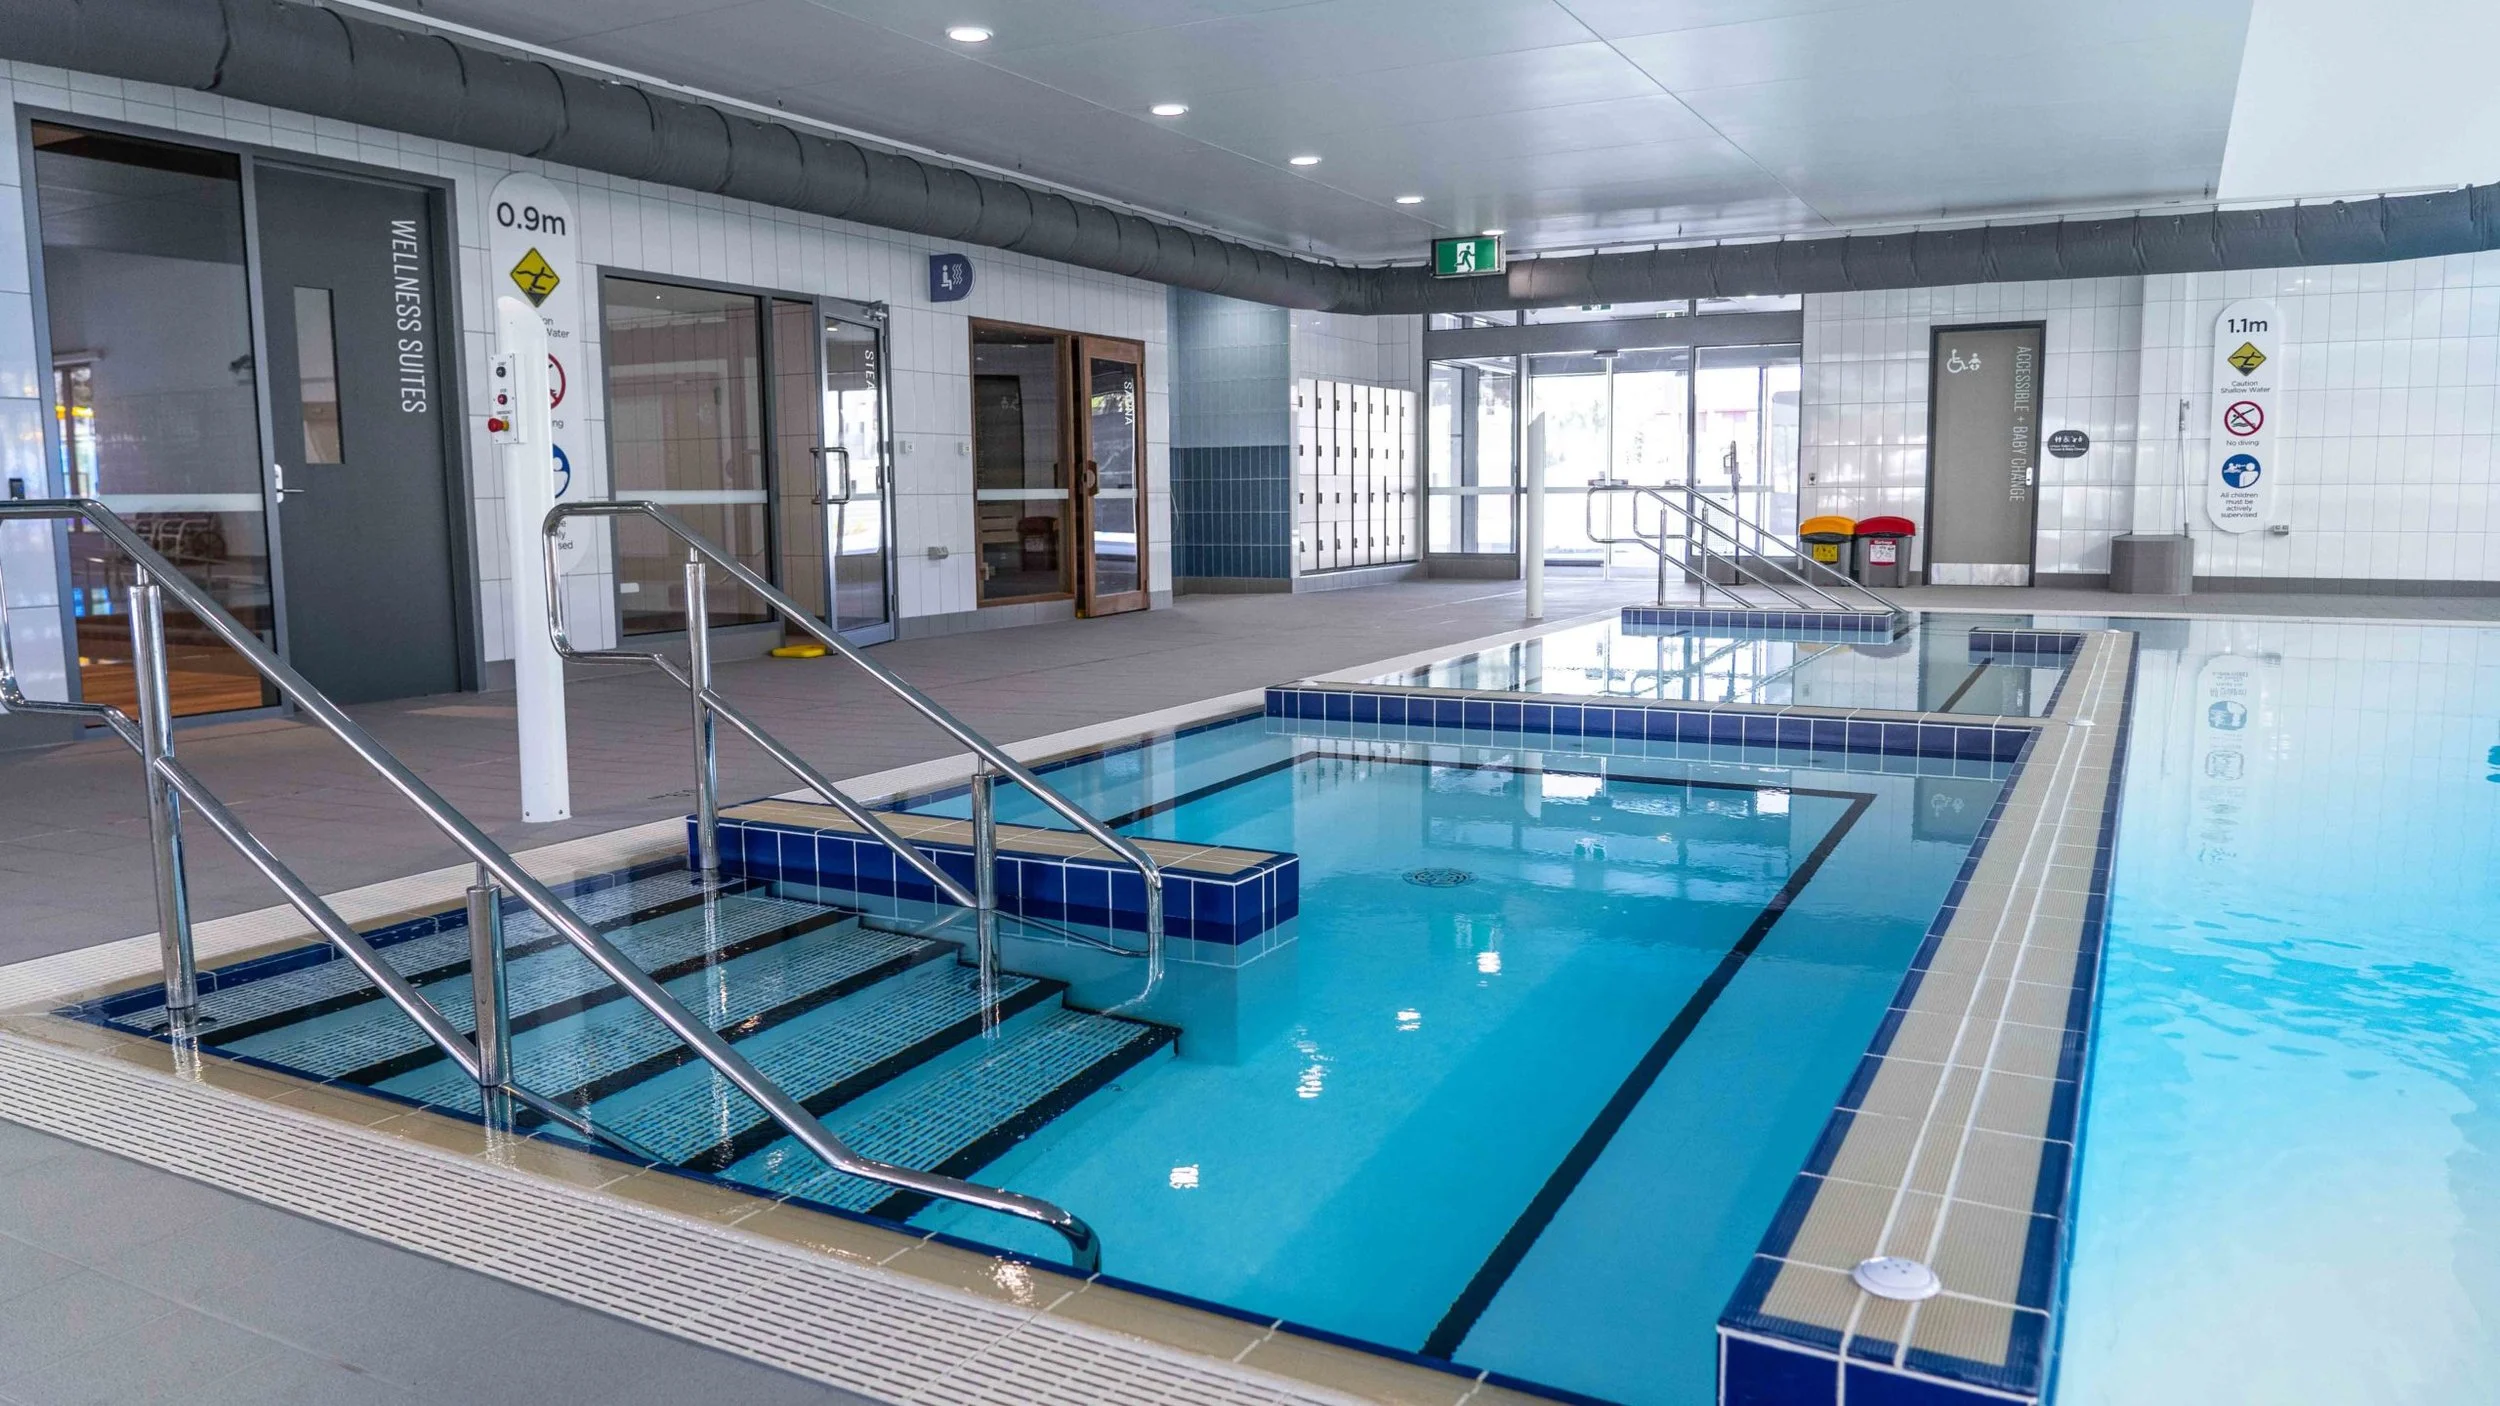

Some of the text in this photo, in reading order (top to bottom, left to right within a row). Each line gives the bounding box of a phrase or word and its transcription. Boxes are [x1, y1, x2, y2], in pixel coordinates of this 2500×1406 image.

[496, 201, 566, 236] 0.9m
[391, 220, 427, 413] WELLNESS SUITES
[2227, 318, 2268, 333] 1.1m
[865, 350, 876, 396] STEA
[2014, 346, 2032, 412] ACCESSIBLE
[2012, 426, 2029, 455] BABY
[2238, 439, 2260, 447] diving
[2009, 457, 2027, 502] CHANGE
